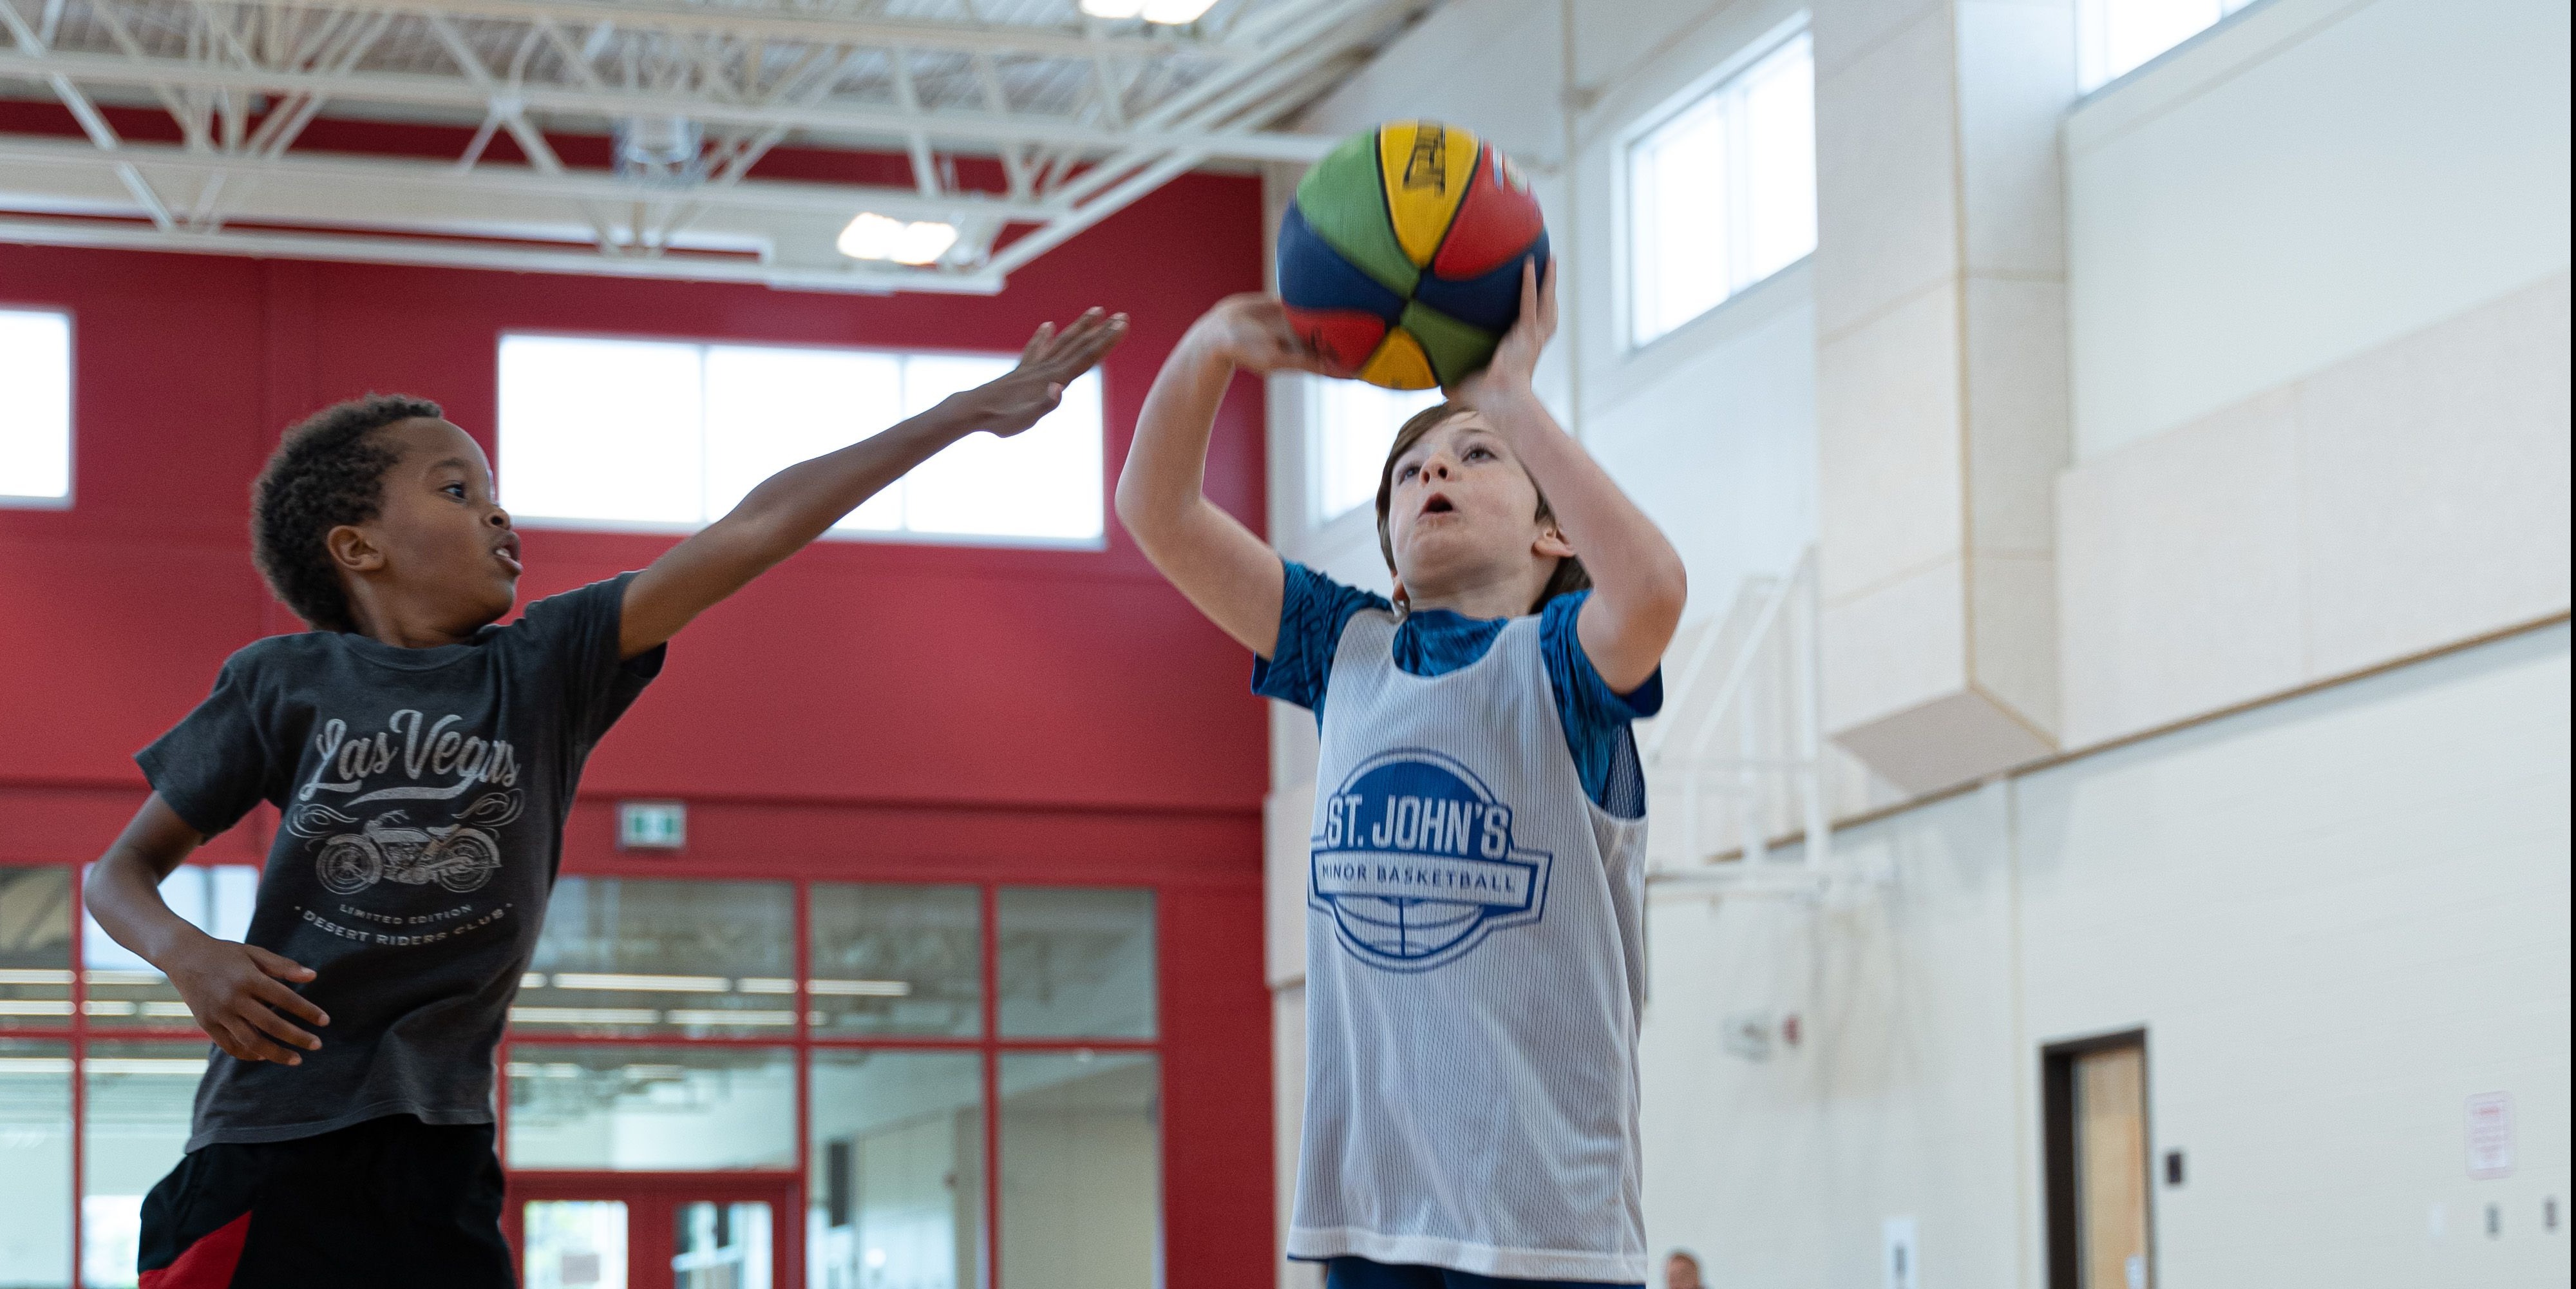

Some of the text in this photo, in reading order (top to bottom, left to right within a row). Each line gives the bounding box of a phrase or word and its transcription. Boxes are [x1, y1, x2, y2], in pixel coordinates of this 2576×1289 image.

[298, 709, 520, 807] Las Vegas
[1327, 793, 1511, 861] ST. JOHN'S
[1321, 862, 1516, 893] MINOR BASKETBALL
[303, 908, 504, 946] DESERT RIDERS CLUB
[339, 904, 472, 924] LIMITED EDITION
